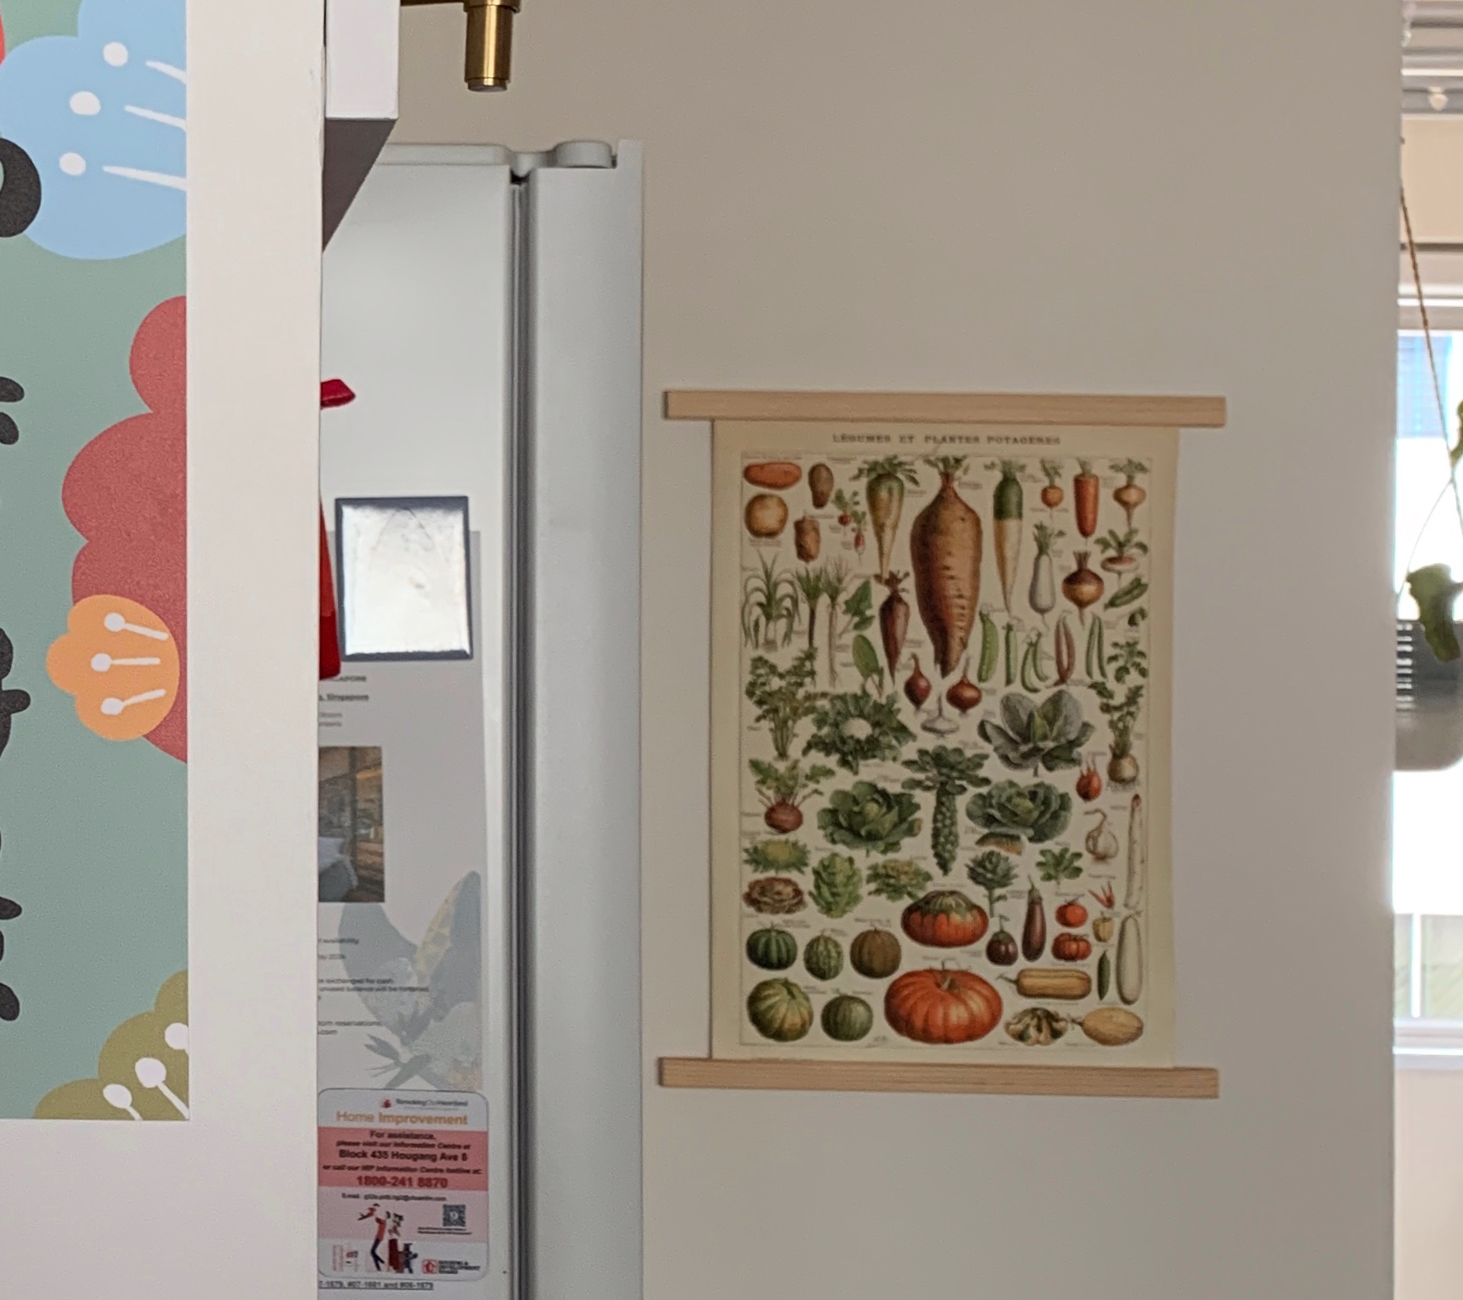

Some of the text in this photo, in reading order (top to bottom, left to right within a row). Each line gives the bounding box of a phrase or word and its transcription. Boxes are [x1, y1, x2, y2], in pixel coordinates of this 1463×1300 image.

[336, 1110, 469, 1125] Home Improvement
[339, 1149, 367, 1158] Block
[391, 1151, 437, 1162] Hougang
[439, 1153, 458, 1161] Ave
